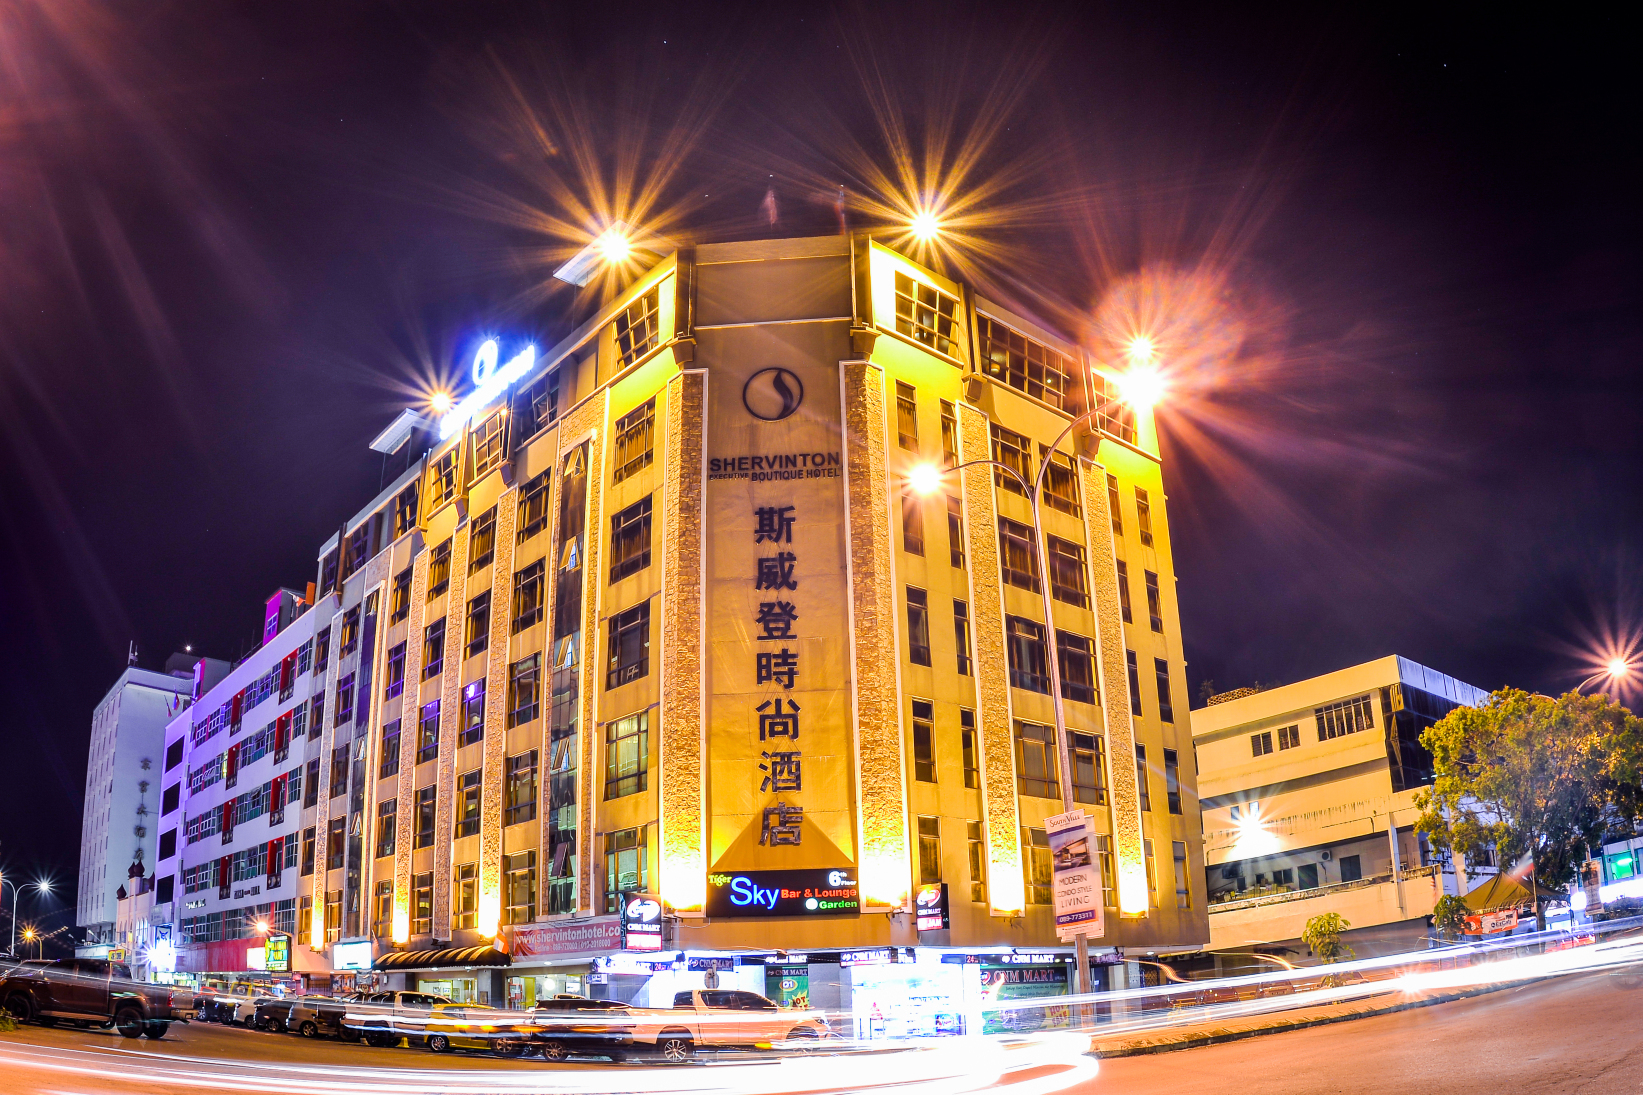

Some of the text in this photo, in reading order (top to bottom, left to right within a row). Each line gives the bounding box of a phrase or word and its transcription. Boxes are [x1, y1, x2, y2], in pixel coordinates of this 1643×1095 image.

[709, 451, 840, 472] SHERVINTON
[709, 467, 841, 482] EXECUTIVE BOUTIQUE HOTEL
[754, 505, 804, 847] 斯威登時尚酒店
[708, 874, 732, 887] Tiger
[1058, 874, 1087, 886] MODERN
[730, 876, 779, 909] Sky
[781, 888, 857, 899] Bar & Lounge
[818, 900, 858, 910] Garden
[1061, 896, 1090, 908] LIVING
[993, 969, 1055, 984] CNM MART
